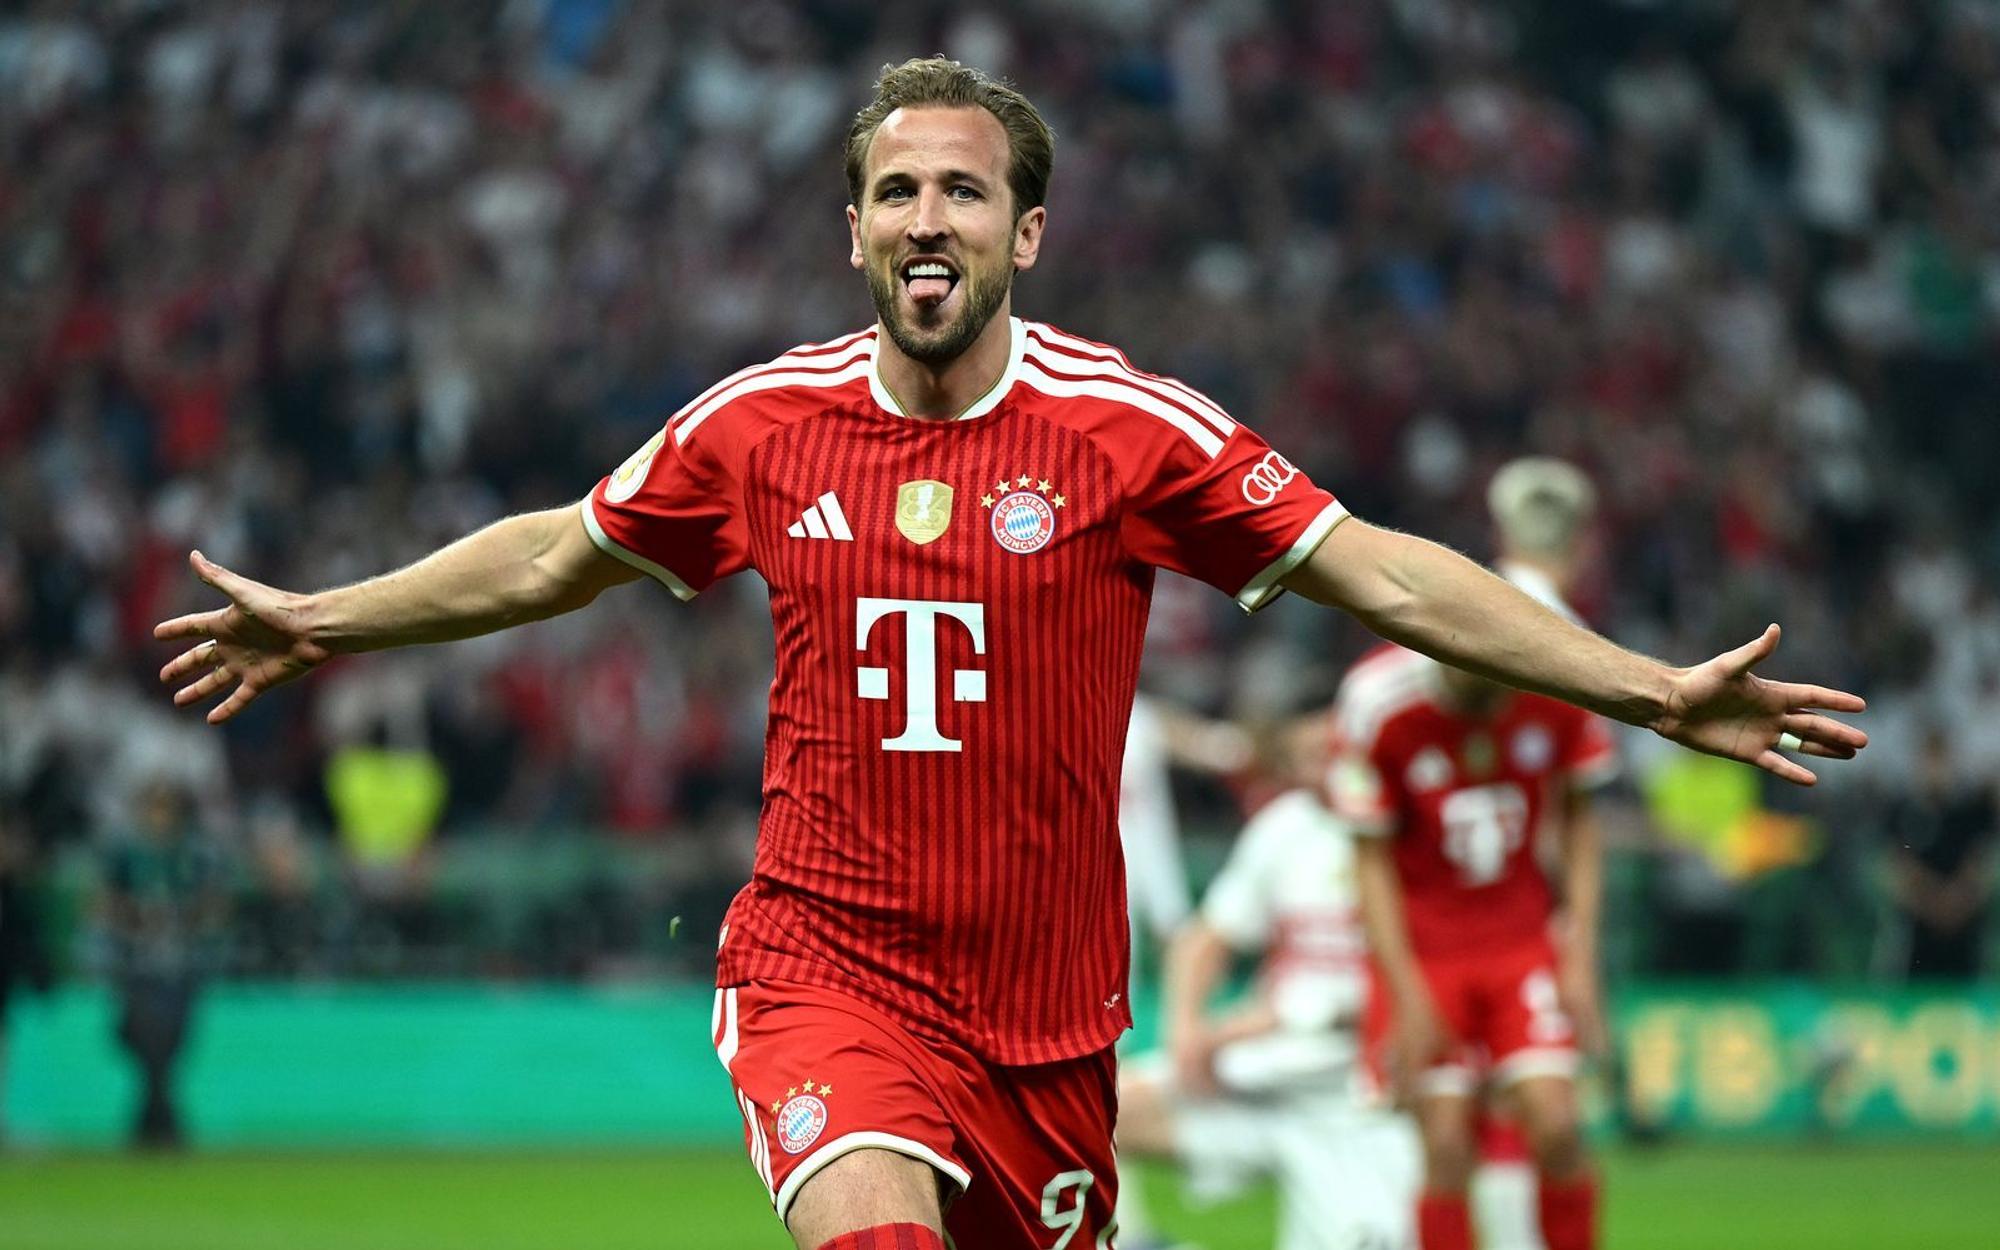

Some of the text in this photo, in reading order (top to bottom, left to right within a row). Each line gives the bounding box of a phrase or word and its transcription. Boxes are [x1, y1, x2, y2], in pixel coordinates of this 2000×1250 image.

[997, 496, 1049, 519] FC BAYERN
[856, 597, 986, 753] T
[1041, 1169, 1094, 1250] 9
